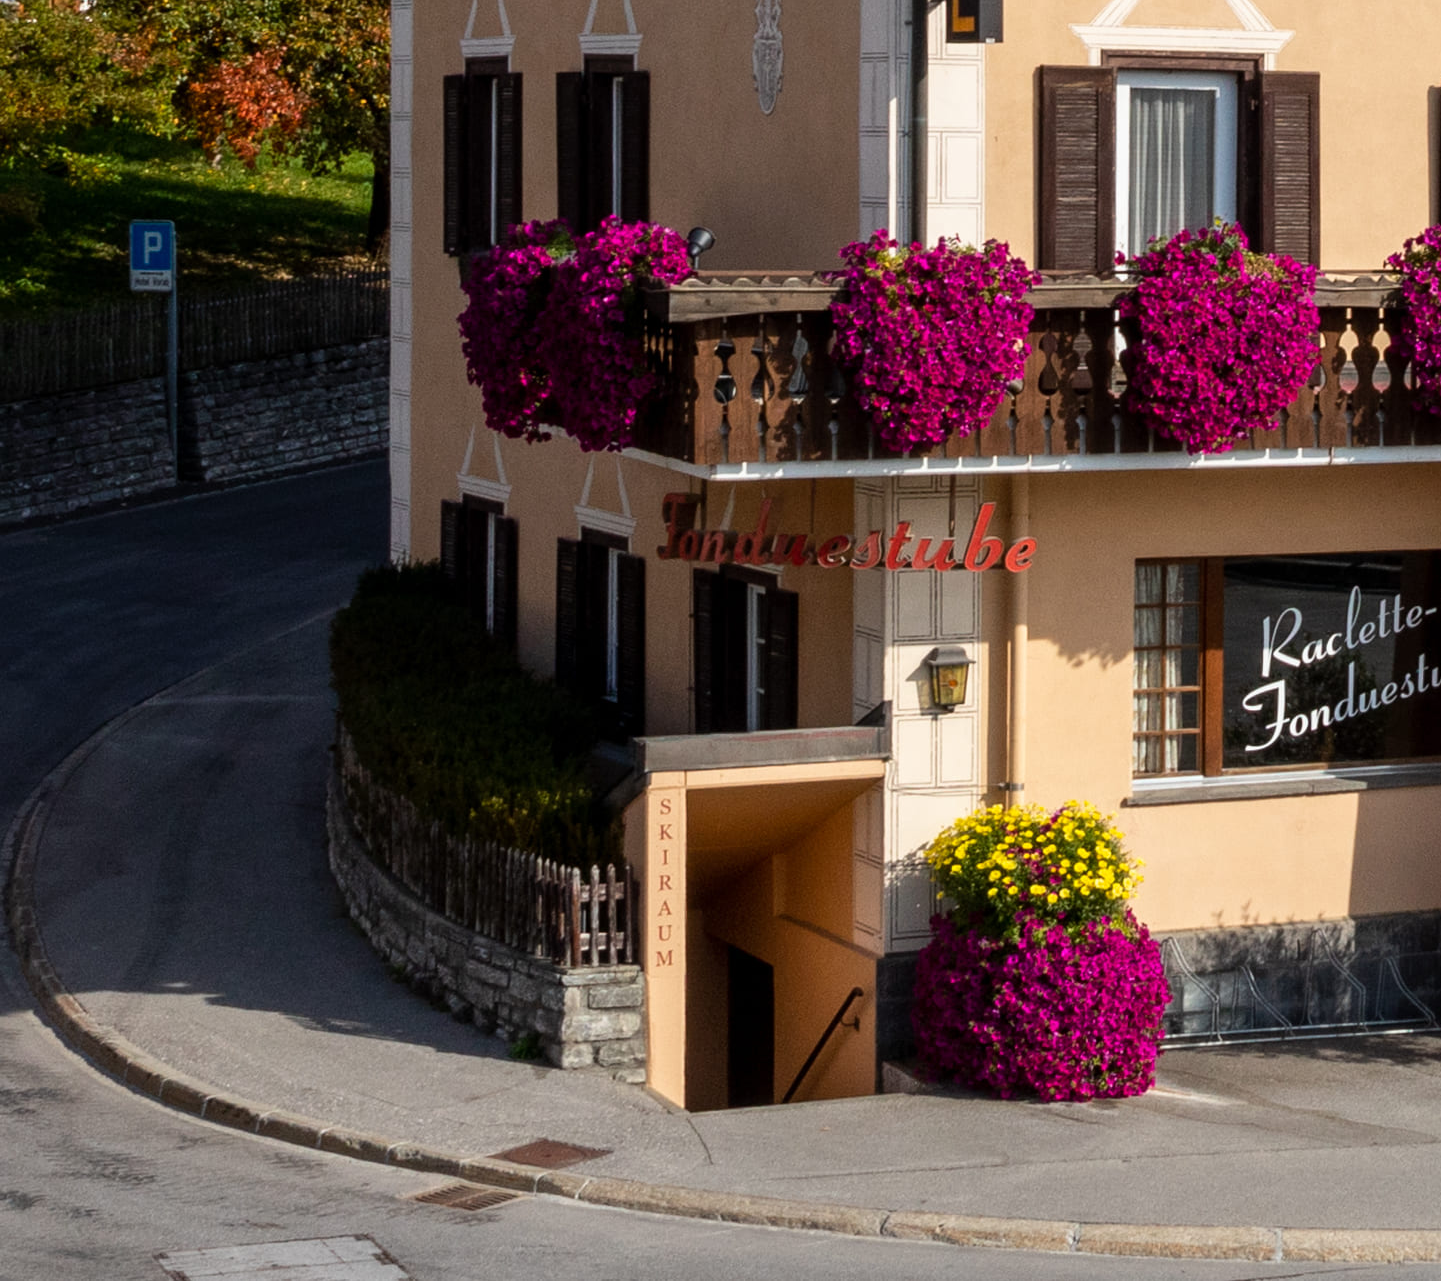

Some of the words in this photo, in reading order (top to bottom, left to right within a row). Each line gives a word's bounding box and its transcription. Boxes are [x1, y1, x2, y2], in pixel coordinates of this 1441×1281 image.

[144, 231, 162, 264] P
[656, 492, 1038, 573] Fonduestube
[656, 798, 673, 967] SKIRAUM
